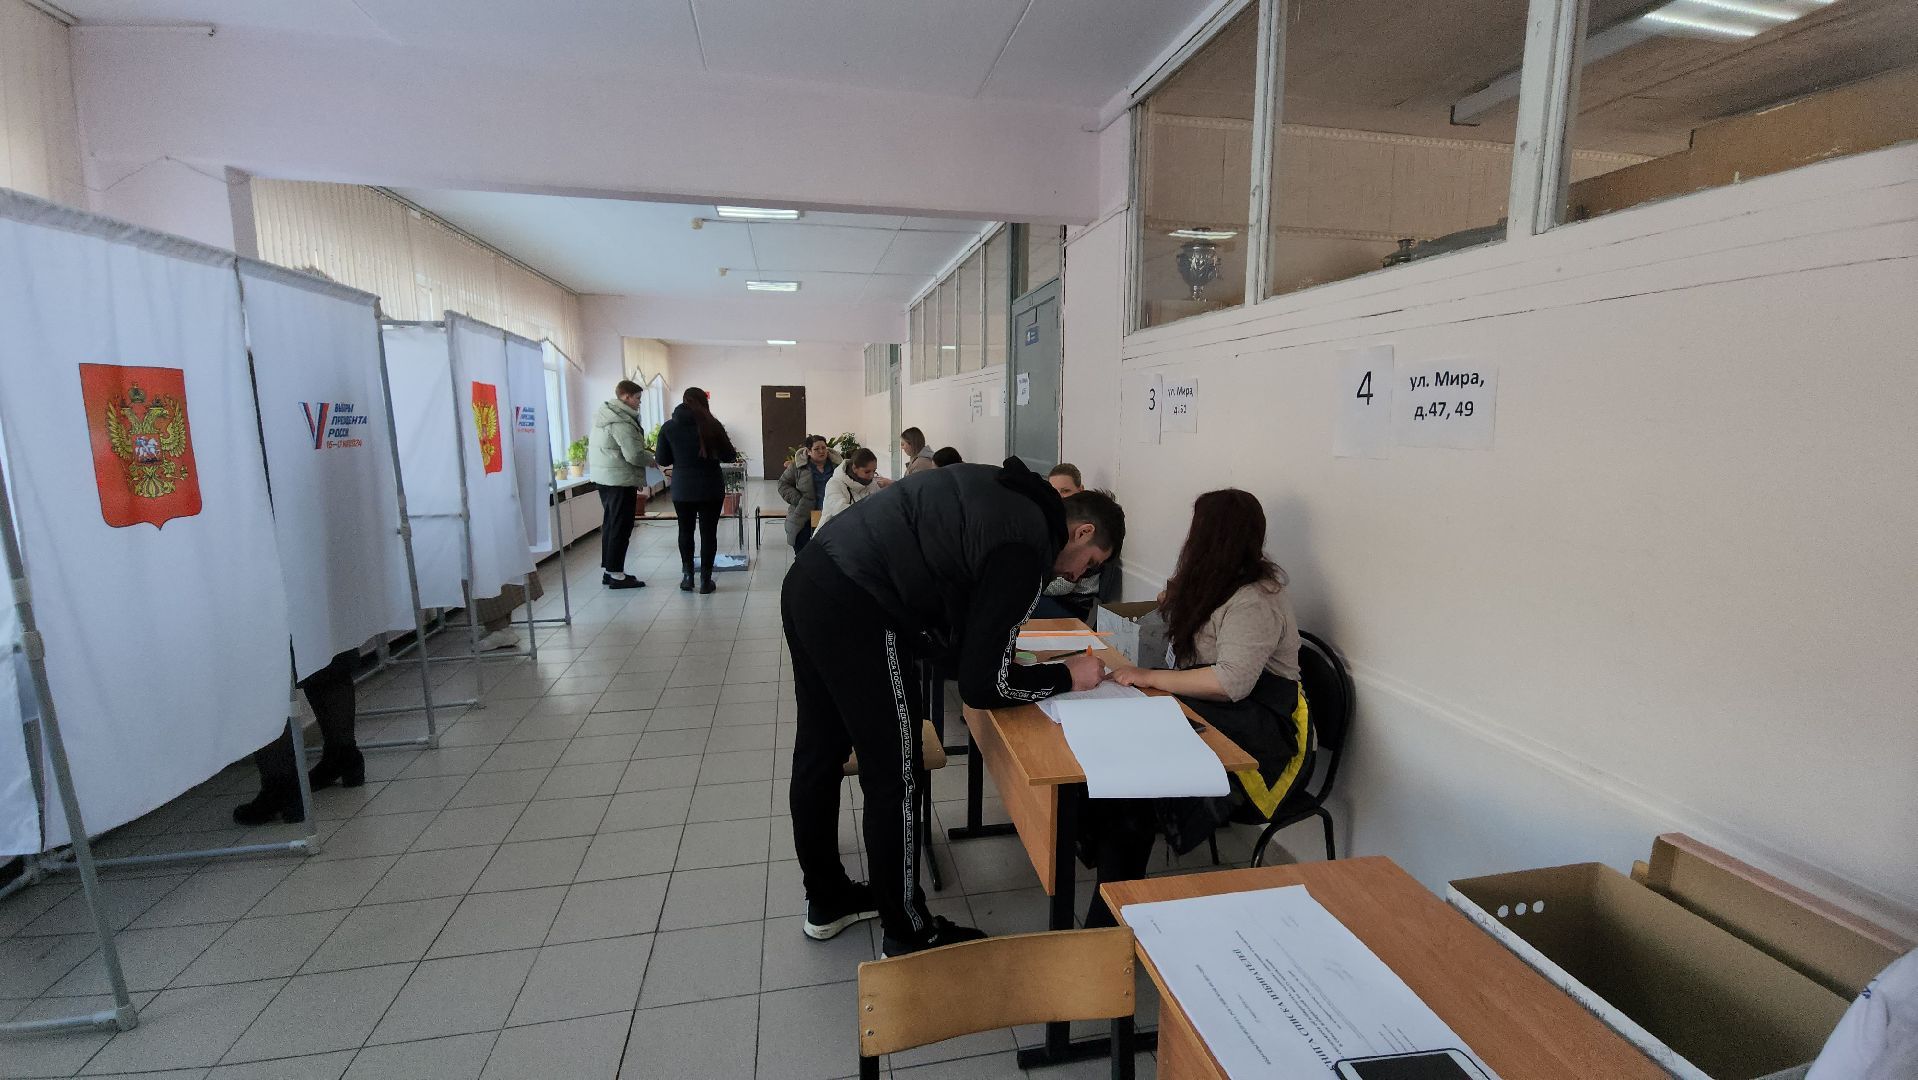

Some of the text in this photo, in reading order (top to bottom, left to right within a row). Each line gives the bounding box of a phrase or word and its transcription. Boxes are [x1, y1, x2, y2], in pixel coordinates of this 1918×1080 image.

[1357, 371, 1373, 406] 4
[1410, 371, 1484, 391] ул. Мира,
[1148, 388, 1156, 410] 3
[1414, 401, 1474, 420] д.47, 49
